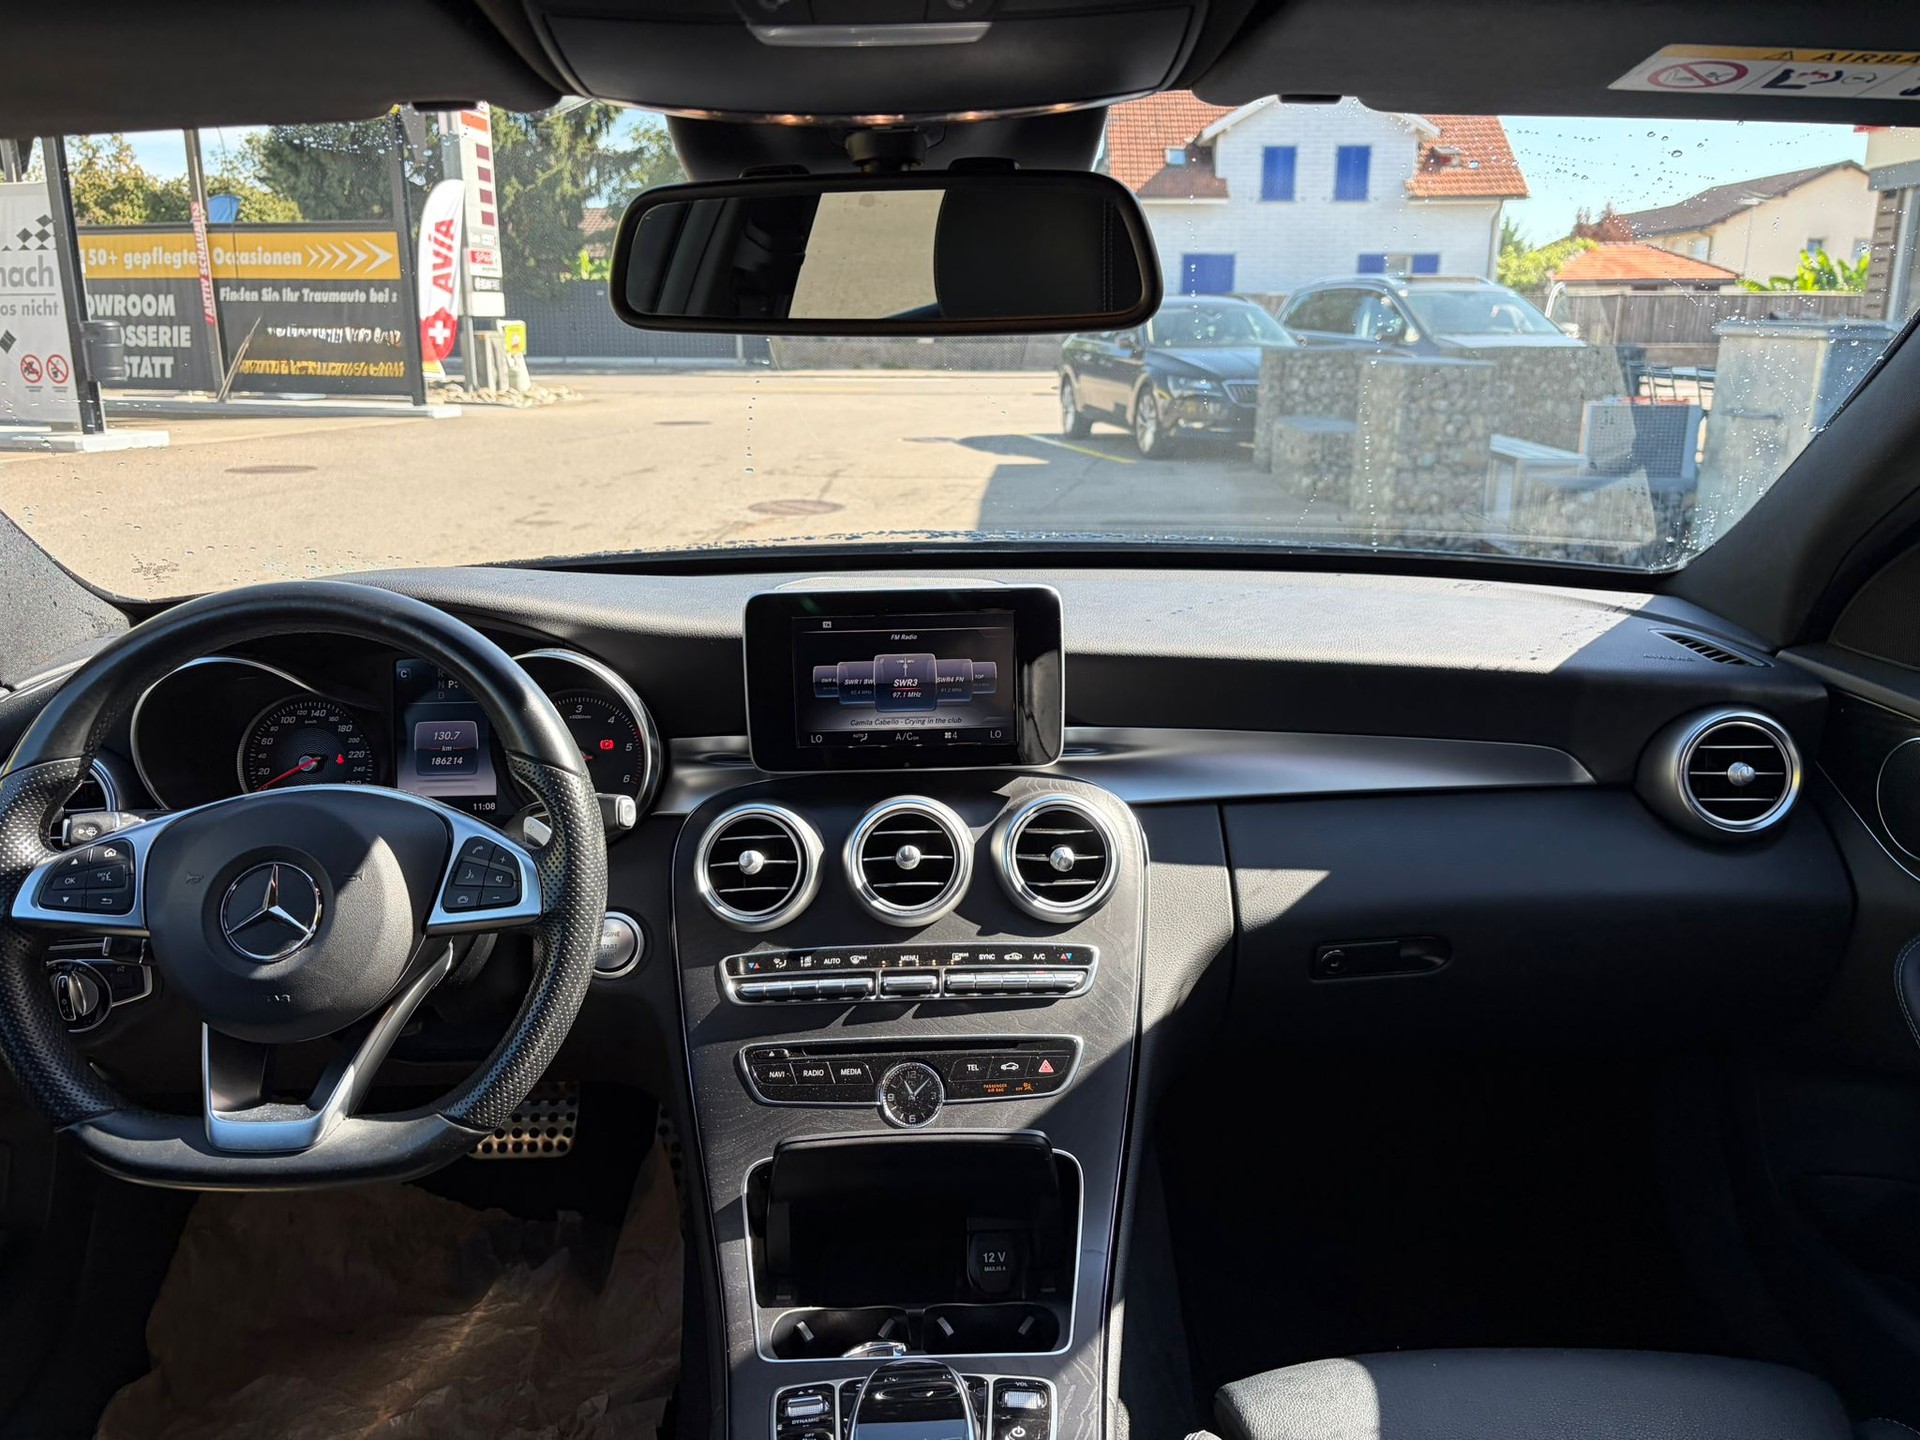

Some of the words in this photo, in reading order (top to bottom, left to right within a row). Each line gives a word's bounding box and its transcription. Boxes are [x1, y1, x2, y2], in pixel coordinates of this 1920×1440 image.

[124, 246, 198, 271] gepflegte
[213, 245, 302, 266] Occasionen
[219, 286, 259, 302] Finden
[282, 286, 301, 302] Ihr
[301, 287, 367, 303] Traumauto
[21, 297, 59, 316] nicht
[400, 669, 407, 679] C
[893, 678, 919, 687] SWR3
[310, 709, 327, 717] 140
[575, 704, 583, 714] 3
[280, 716, 296, 724] 100
[607, 715, 615, 724] 4
[850, 719, 873, 727] Camila
[874, 718, 899, 726] Cabello
[904, 717, 926, 727] Crying
[927, 717, 934, 725] in
[337, 724, 353, 733] 180
[433, 731, 460, 741] 130.7
[810, 734, 823, 744] LO
[895, 732, 913, 741] A/C
[952, 731, 958, 740] 4
[989, 730, 1002, 739] LO
[261, 737, 274, 746] 60
[625, 742, 633, 752] 5
[348, 750, 365, 759] 220
[431, 756, 463, 766] 186214
[257, 767, 271, 776] 20
[623, 774, 631, 783] 6
[473, 802, 496, 811] 11:08
[64, 877, 76, 885] OK
[823, 957, 841, 965] AUTO
[900, 953, 919, 962] MENU
[966, 1063, 980, 1072] TEL
[769, 1070, 785, 1079] NAVI
[802, 1069, 825, 1077] RADIO
[840, 1068, 862, 1076] MEDIA
[909, 1114, 917, 1123] 6
[983, 1252, 995, 1263] 12
[997, 1251, 1006, 1263] V
[791, 1417, 820, 1425] DYNAMIC
